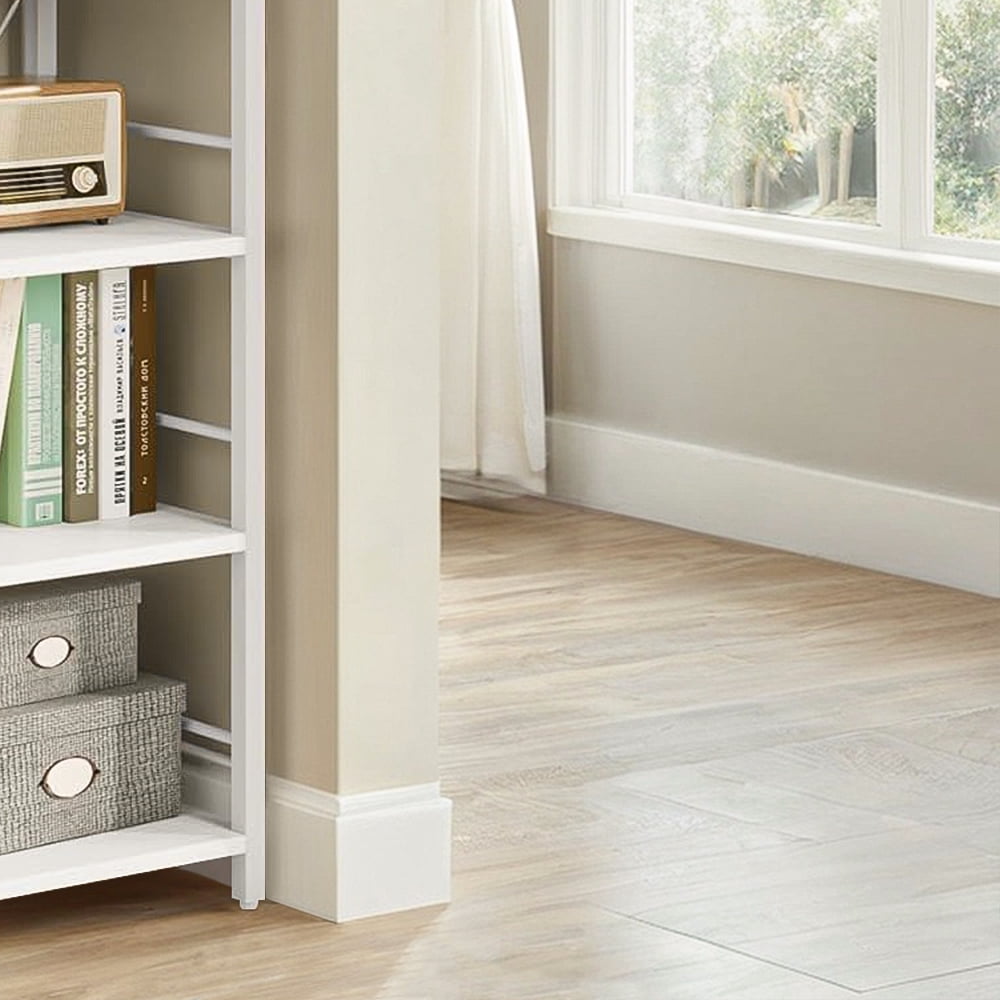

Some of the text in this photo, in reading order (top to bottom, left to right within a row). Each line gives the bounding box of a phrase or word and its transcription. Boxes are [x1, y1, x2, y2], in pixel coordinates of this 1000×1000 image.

[75, 283, 88, 496] FOREX: ОТ ПРОСТОГО К СЛОЖНОМУ
[114, 454, 126, 468] НА
